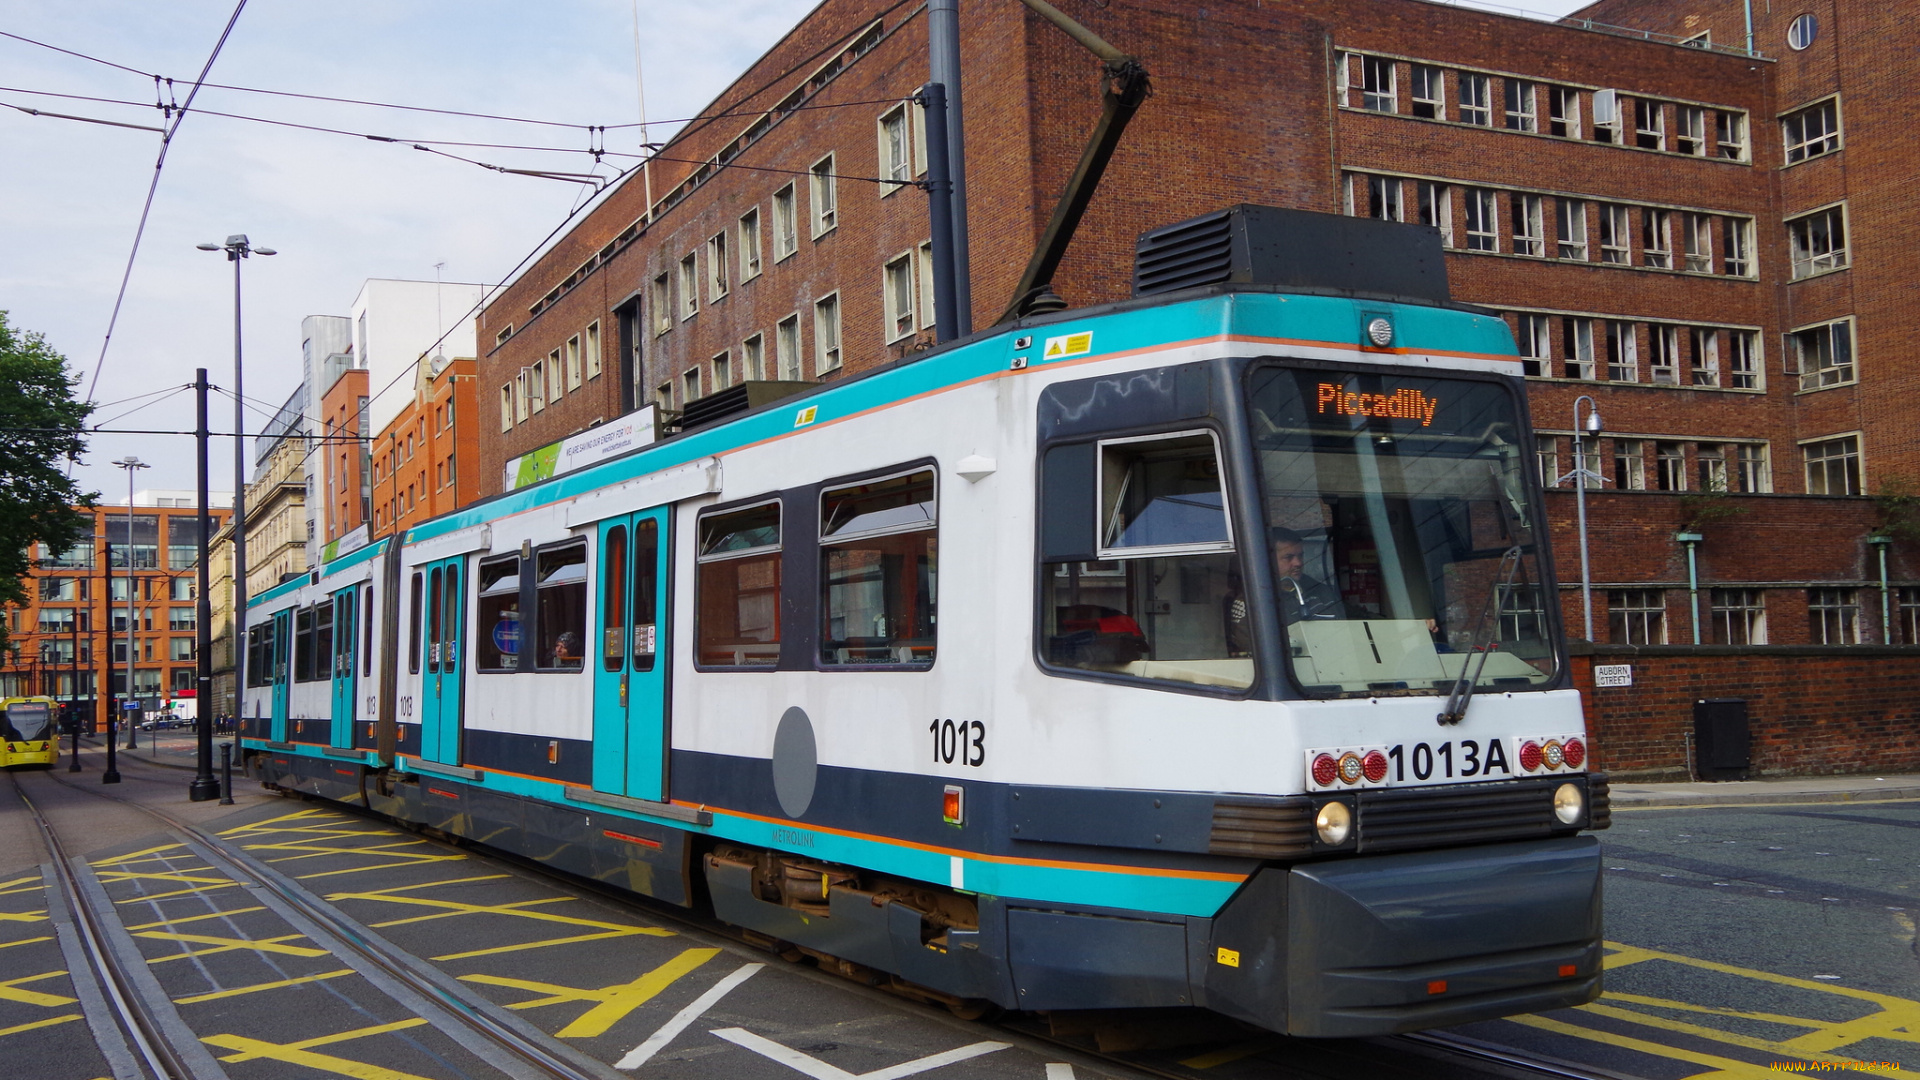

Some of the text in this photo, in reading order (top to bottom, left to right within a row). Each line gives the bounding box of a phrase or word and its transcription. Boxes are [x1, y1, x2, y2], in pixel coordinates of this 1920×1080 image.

[1318, 383, 1437, 427] Piccadilly
[579, 439, 593, 453] SAVING
[600, 432, 615, 445] ENERGY
[616, 428, 624, 439] FOR
[1600, 675, 1626, 685] STREET
[400, 696, 413, 717] 1013
[929, 718, 986, 768] 1013
[1388, 738, 1511, 782] 1013A
[772, 829, 815, 848] METROLINK
